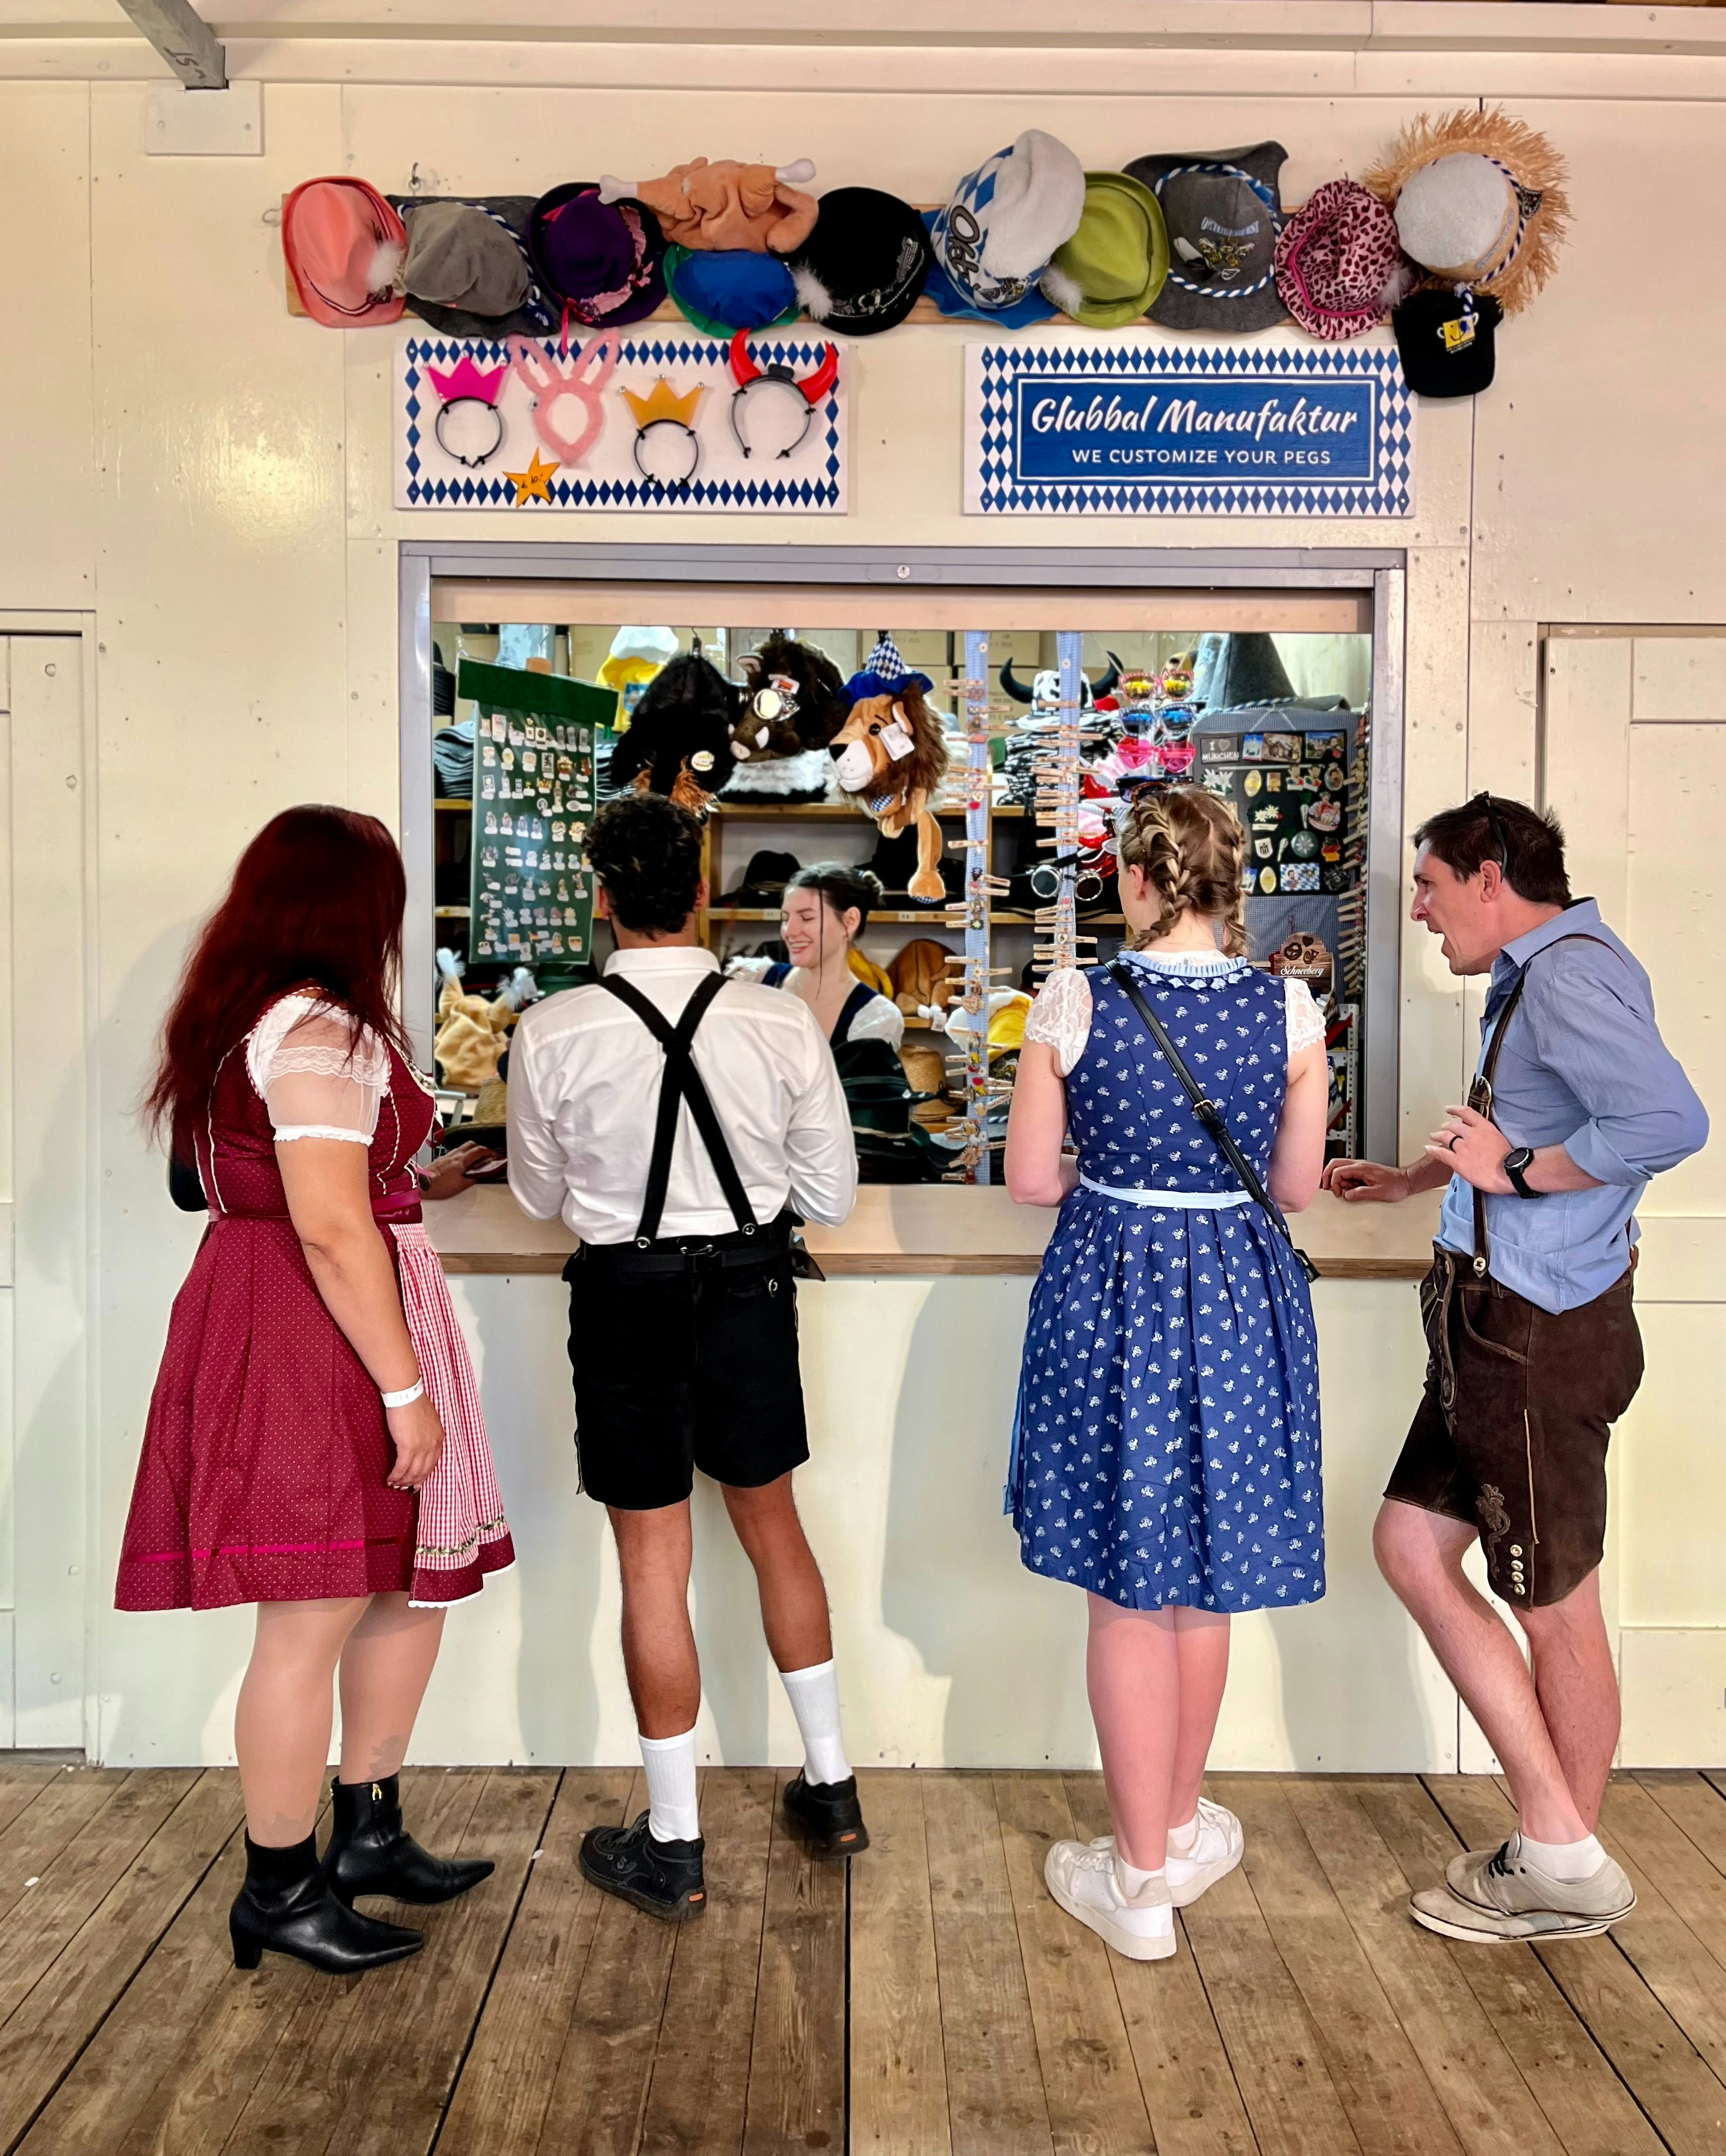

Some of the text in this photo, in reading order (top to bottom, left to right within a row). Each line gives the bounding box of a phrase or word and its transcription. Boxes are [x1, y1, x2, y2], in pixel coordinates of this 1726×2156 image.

[1032, 395, 1357, 442] Glubbal Manufaktur
[1072, 449, 1331, 464] WE CUSTOMIZE YOUR PEGS
[1210, 741, 1215, 750] I
[1280, 964, 1323, 977] Schneeberg
